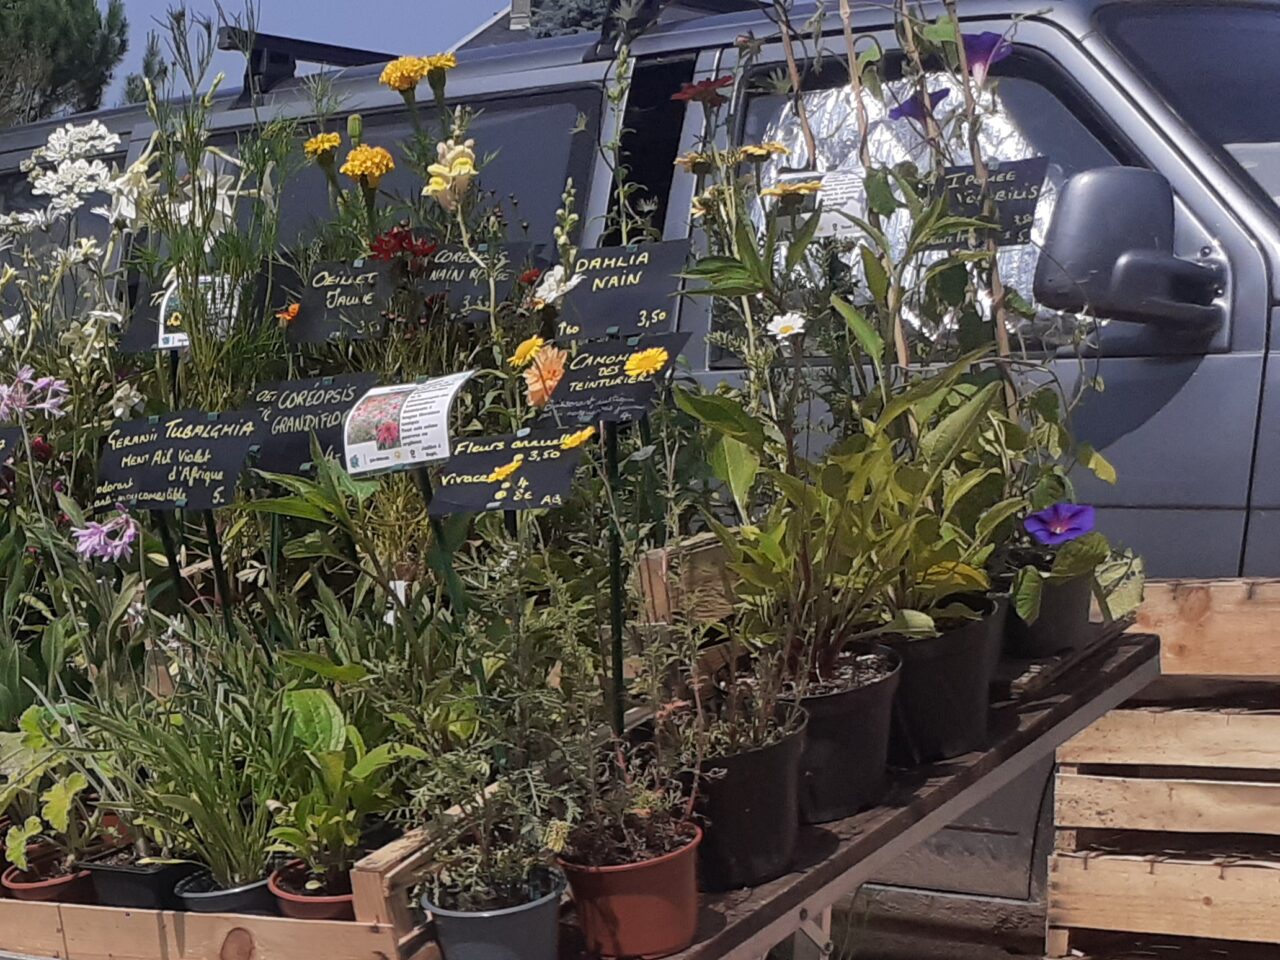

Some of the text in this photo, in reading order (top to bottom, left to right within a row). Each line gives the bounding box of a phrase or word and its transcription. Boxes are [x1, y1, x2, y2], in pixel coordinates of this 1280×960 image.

[575, 252, 650, 274] DAHLIA
[592, 271, 643, 292] NAIN
[637, 308, 667, 328] 3,50
[570, 351, 632, 371] CAMOM
[454, 440, 505, 456] Fleurs
[528, 450, 560, 462] 3,50
